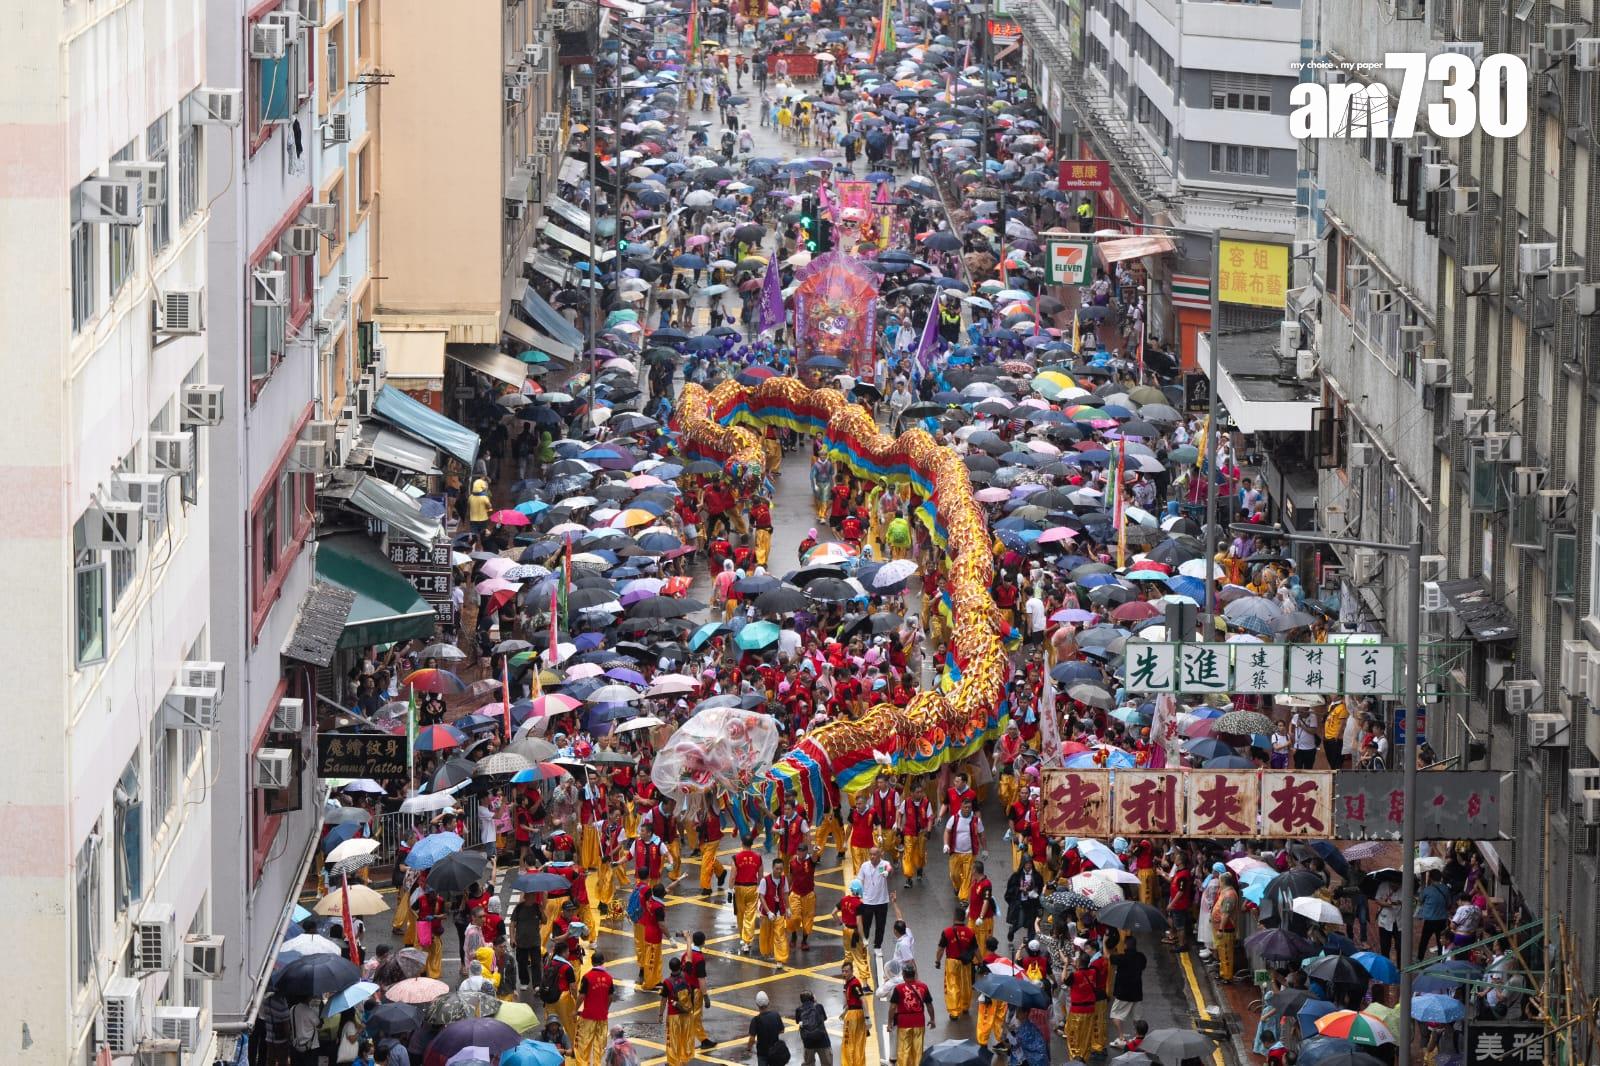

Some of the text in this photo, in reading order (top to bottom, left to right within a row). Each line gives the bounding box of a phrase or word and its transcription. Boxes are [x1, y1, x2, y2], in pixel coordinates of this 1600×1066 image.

[323, 758, 404, 776] Sammy Tattoo
[1049, 774, 1325, 833] 宏利夾板
